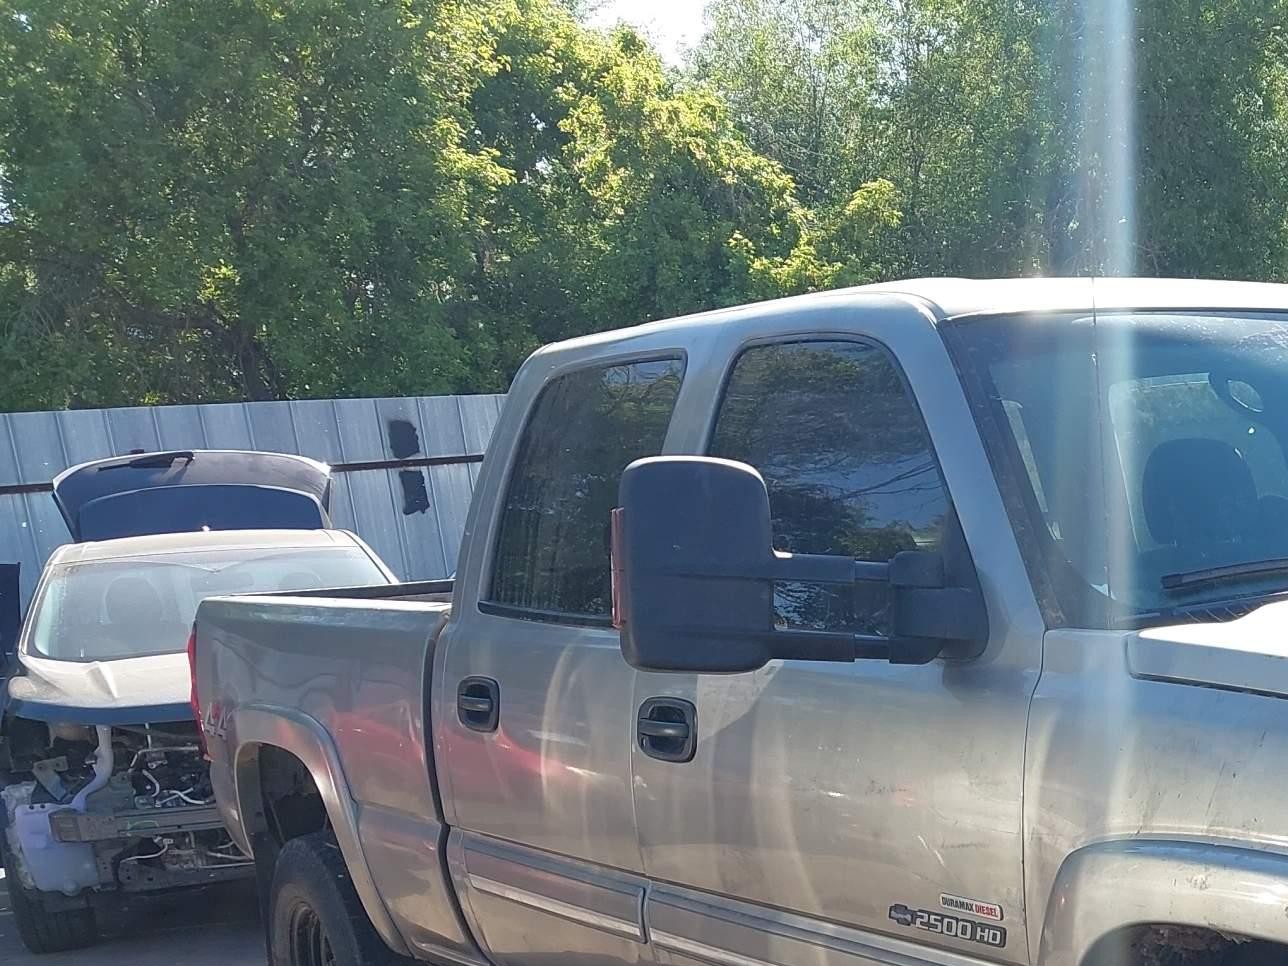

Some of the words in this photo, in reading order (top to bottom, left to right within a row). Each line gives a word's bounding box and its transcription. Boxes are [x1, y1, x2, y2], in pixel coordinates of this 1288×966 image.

[941, 896, 975, 913] DURAMAX
[974, 903, 1000, 918] DIESEL
[915, 912, 972, 941] 2500
[976, 926, 1002, 945] HD
